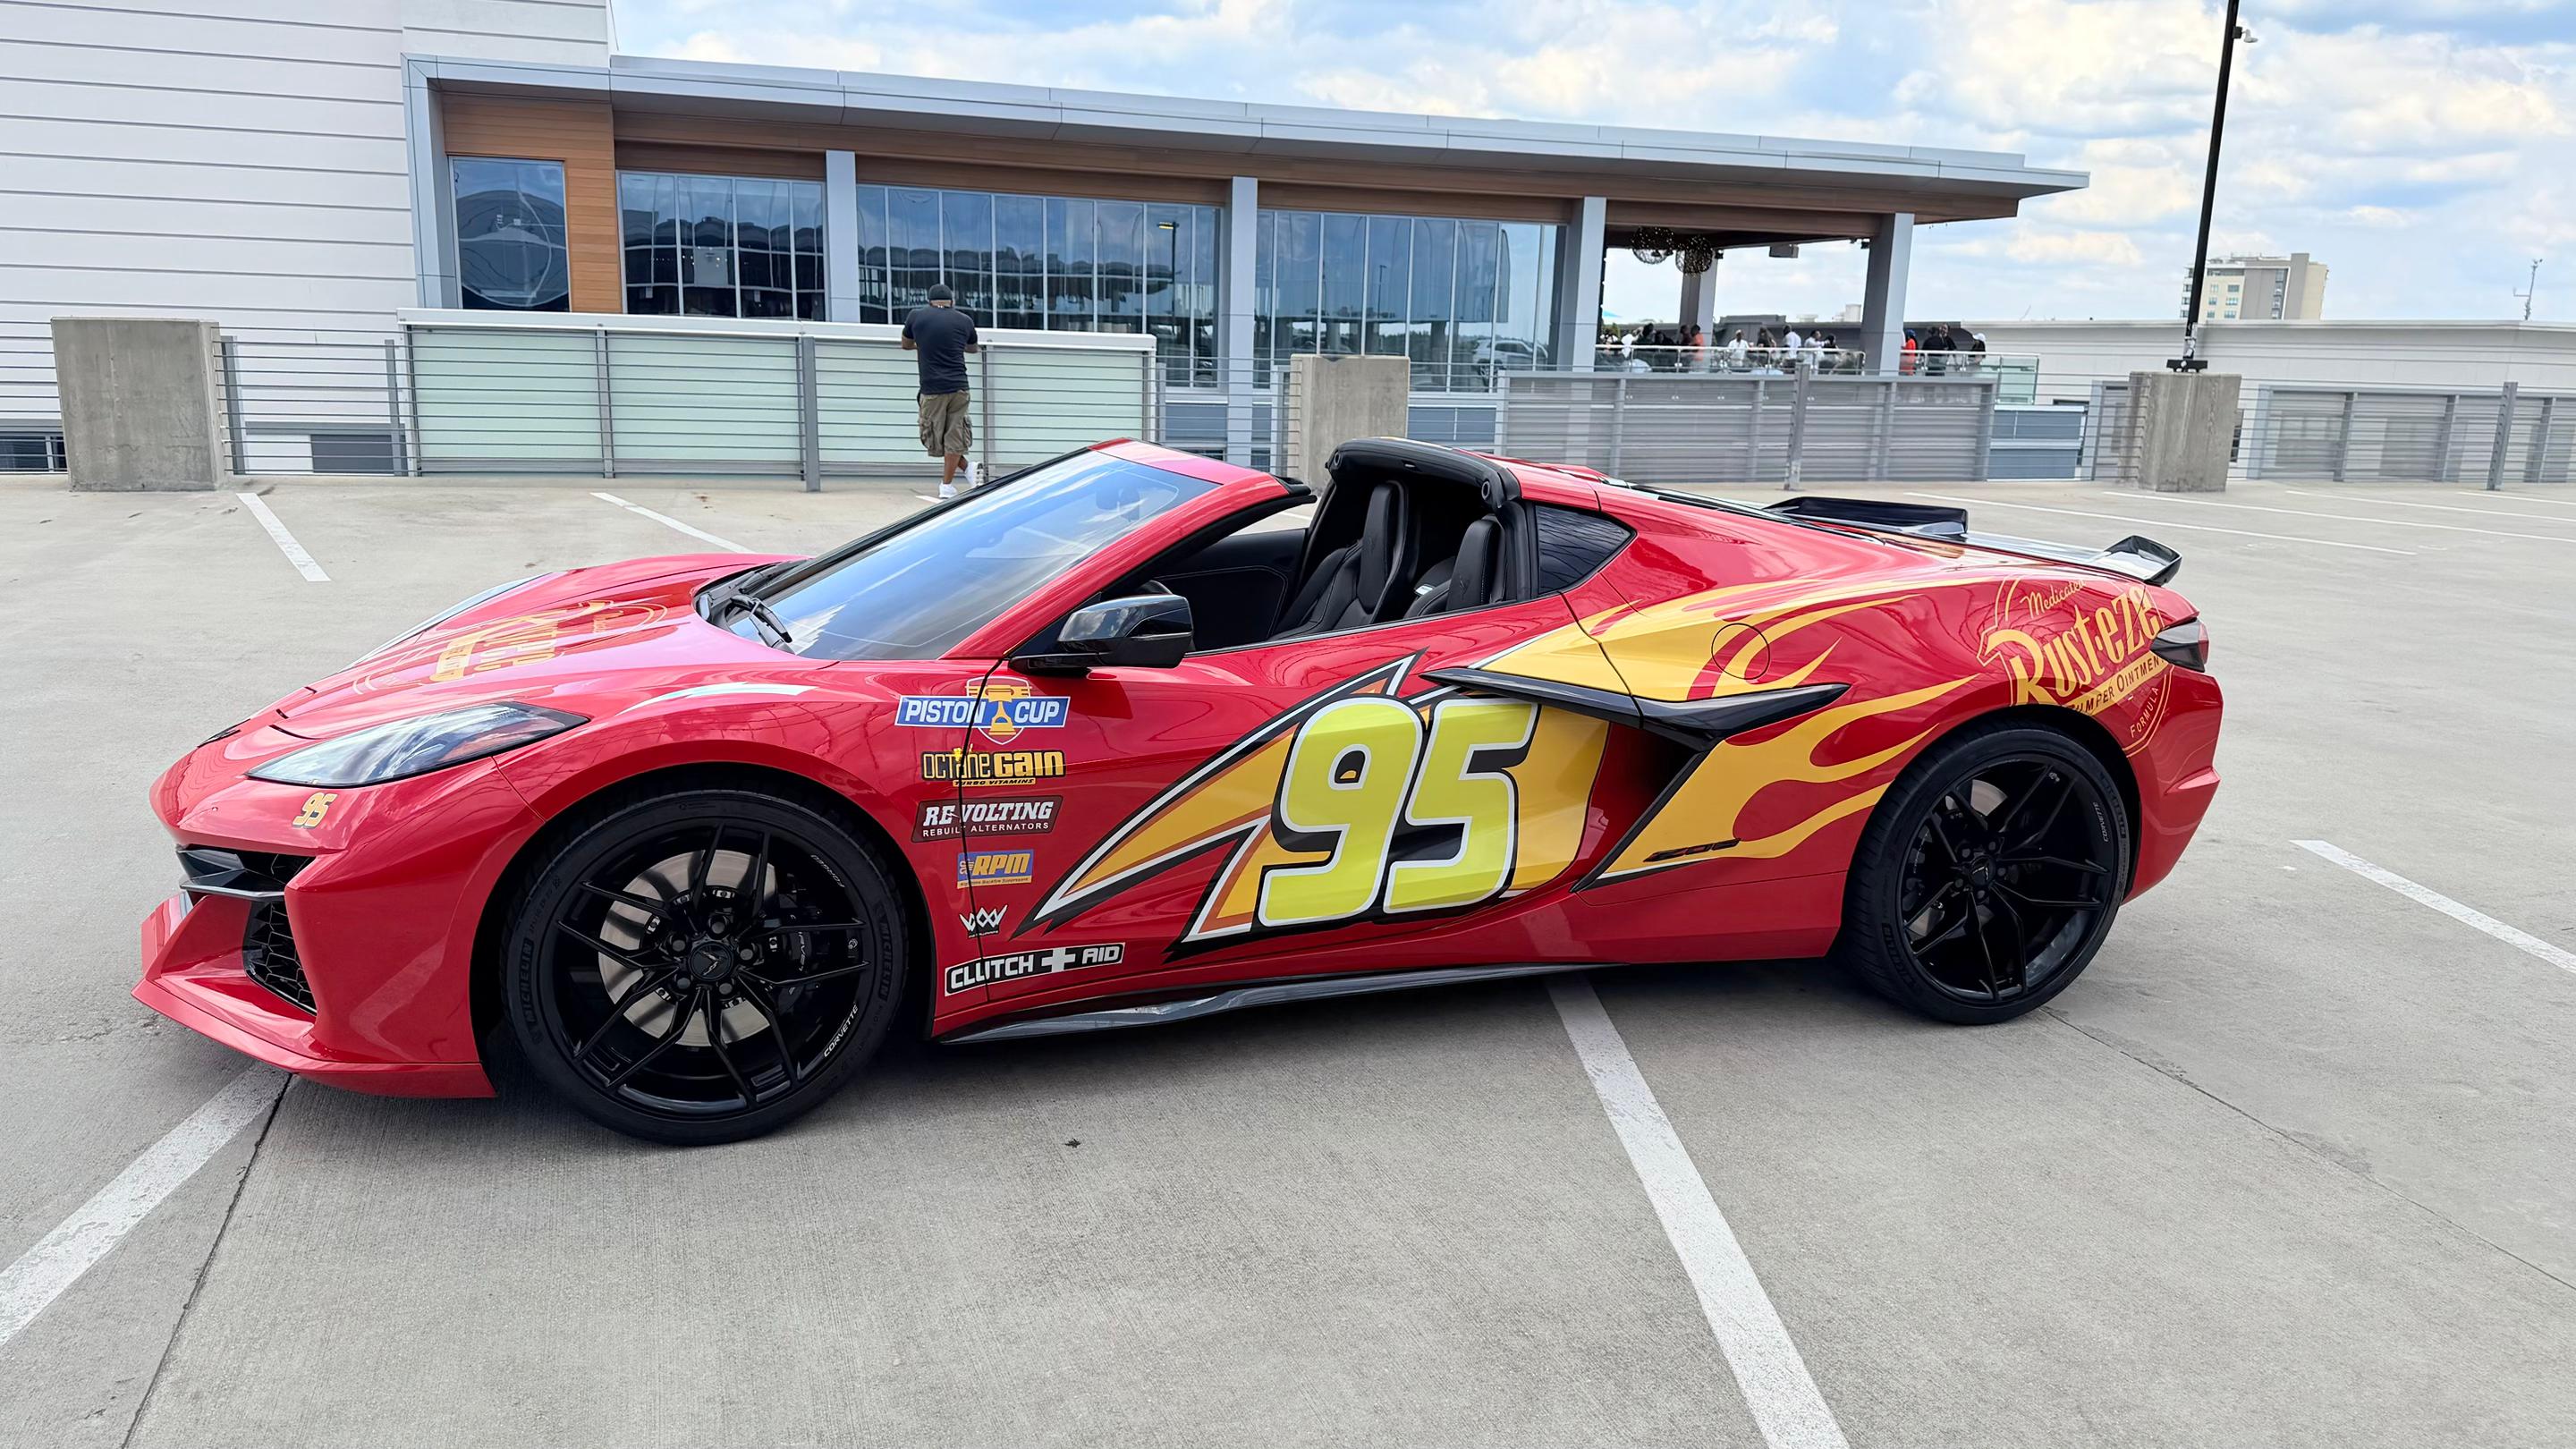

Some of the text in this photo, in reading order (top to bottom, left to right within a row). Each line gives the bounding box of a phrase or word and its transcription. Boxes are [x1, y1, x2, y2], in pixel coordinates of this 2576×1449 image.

[2116, 656, 2164, 692] OINTMEN
[905, 699, 1060, 724] PISTON CUP
[2130, 687, 2159, 738] FORMULA
[292, 792, 339, 827] 95
[970, 822, 1049, 833] ALTERNATORS
[1258, 697, 1539, 928] 95
[972, 853, 1030, 876] RPM
[521, 943, 537, 1022] MICHELIN
[879, 922, 893, 1000] MICHELIN
[951, 946, 1120, 989] CLUTCH AID
[824, 1004, 859, 1057] CORVETTE
